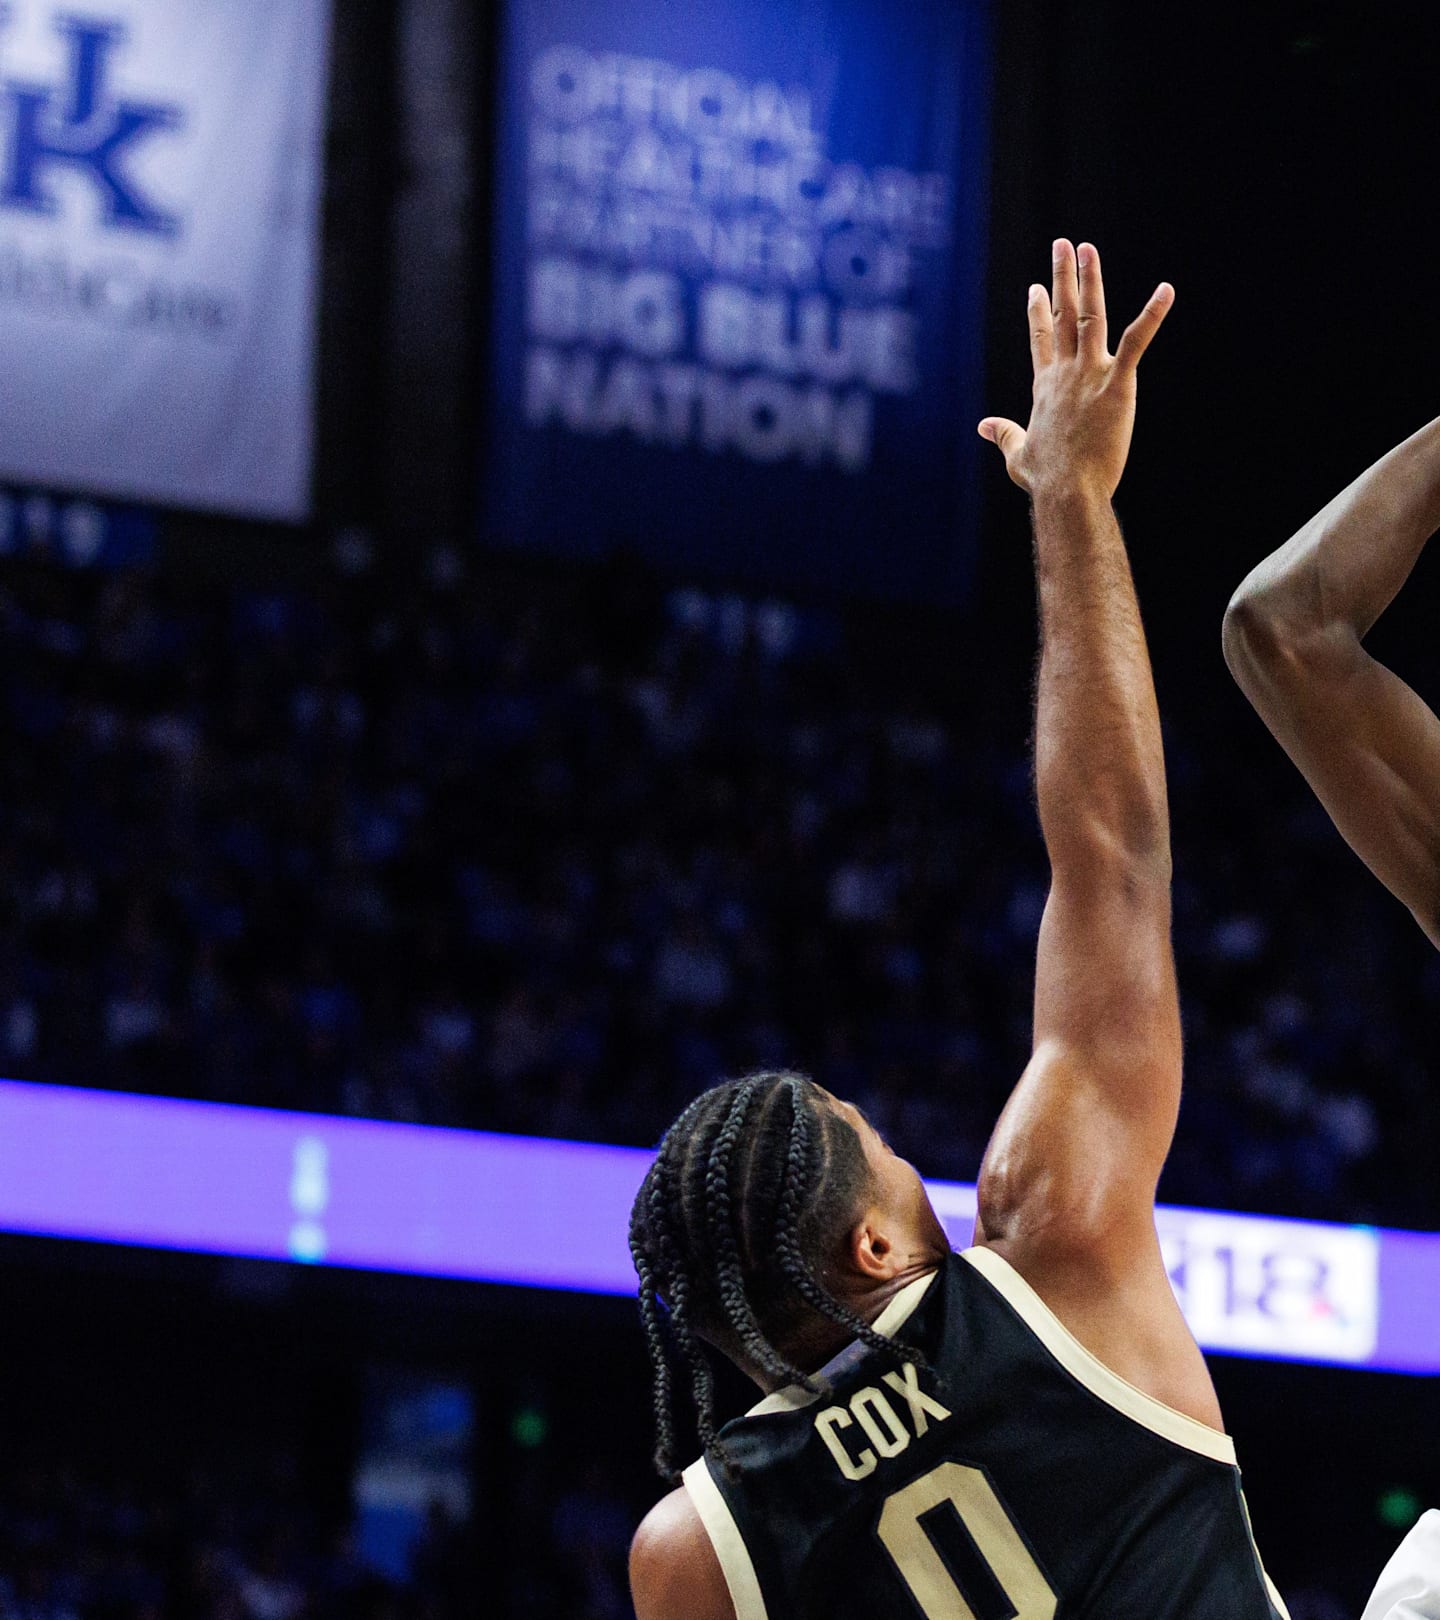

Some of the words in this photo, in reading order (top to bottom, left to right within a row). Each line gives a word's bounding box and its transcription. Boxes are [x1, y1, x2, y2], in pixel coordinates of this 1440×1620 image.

[530, 43, 815, 140] OFFICIAL
[530, 124, 950, 248] HEALTHCARE
[530, 182, 822, 284] PARTNER
[825, 224, 912, 297] OF
[530, 258, 681, 354] BIG
[701, 282, 916, 395] BLUE
[526, 345, 872, 474] NATION
[814, 1362, 952, 1481] COX
[874, 1459, 1059, 1620] 0
